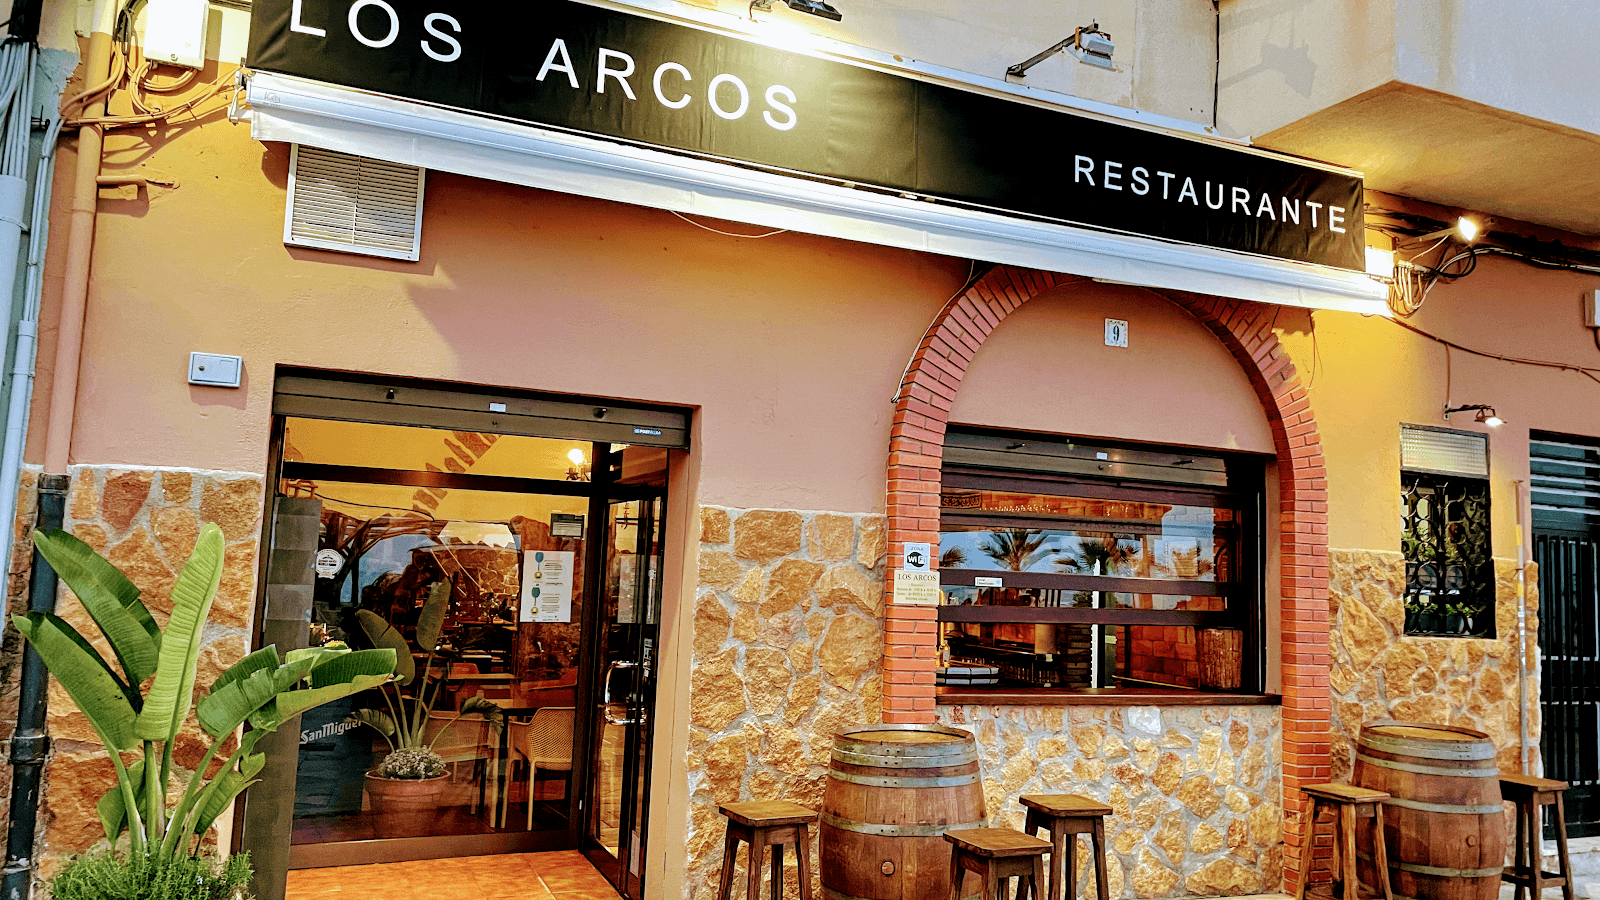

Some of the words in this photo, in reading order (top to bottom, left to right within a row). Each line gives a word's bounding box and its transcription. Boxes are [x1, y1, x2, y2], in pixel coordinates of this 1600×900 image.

[290, 0, 462, 63] LOS
[535, 37, 798, 132] ARCOS
[1074, 154, 1347, 234] RESTAURANTE
[1112, 325, 1120, 342] 9
[898, 573, 912, 581] LOS
[913, 574, 937, 582] ARCOS
